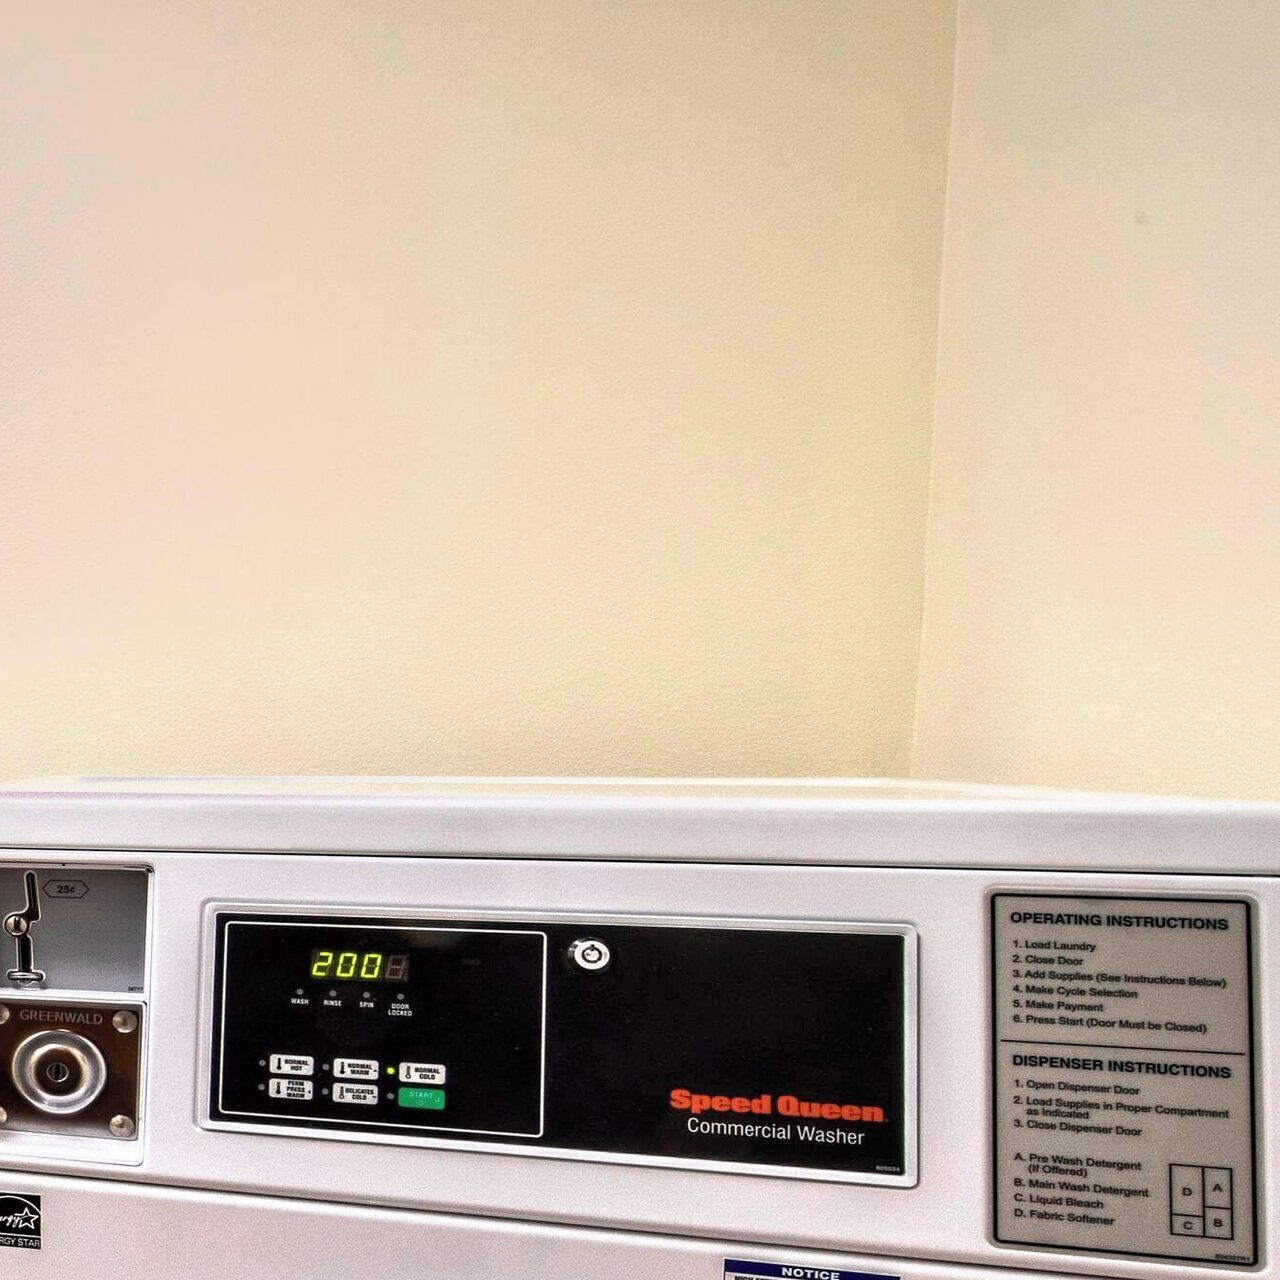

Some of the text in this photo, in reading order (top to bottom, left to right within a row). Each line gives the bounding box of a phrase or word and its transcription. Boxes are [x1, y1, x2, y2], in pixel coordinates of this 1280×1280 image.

[1010, 912, 1229, 930] OPERATING INSTRUCTIONS
[1014, 940, 1096, 952] 1. Load Laundry
[312, 951, 382, 978] 200
[1013, 955, 1083, 965] 2. Close Door
[1013, 970, 1226, 989] 3. Add Supplies (See Instructions Below)
[1013, 985, 1137, 998] 4. Make Cycle Selection
[1013, 1000, 1103, 1012] 5. Make Payment
[20, 1009, 103, 1026] GREENWALD
[1013, 1015, 1207, 1034] 6. Press Start (Door Must be Closed)
[1013, 1055, 1231, 1078] DISPENSER INSTRUCTIONS
[1014, 1079, 1140, 1095] 1. Open Dispenser Door
[670, 1088, 883, 1122] Speed Queen
[1014, 1096, 1229, 1119] 2. Load Supplies in Proper Compartment
[1042, 1108, 1089, 1119] Indicated
[688, 1117, 865, 1145] Commercial Washer
[1014, 1120, 1142, 1136] 3. Close Dispenser Door
[1014, 1153, 1141, 1171] A. Pre Wash Detergent
[1028, 1164, 1087, 1178] (If Offered)
[1014, 1178, 1149, 1197] B. Main Wash Detergent
[1183, 1188, 1192, 1196] D
[1213, 1184, 1223, 1192] A
[1014, 1193, 1104, 1209] C. Liquid Bleach
[1014, 1208, 1115, 1225] D. Fabric Softener
[1214, 1219, 1223, 1227] B
[1183, 1222, 1193, 1230] C
[18, 1238, 40, 1247] STAR
[782, 1267, 840, 1280] NOTICE
